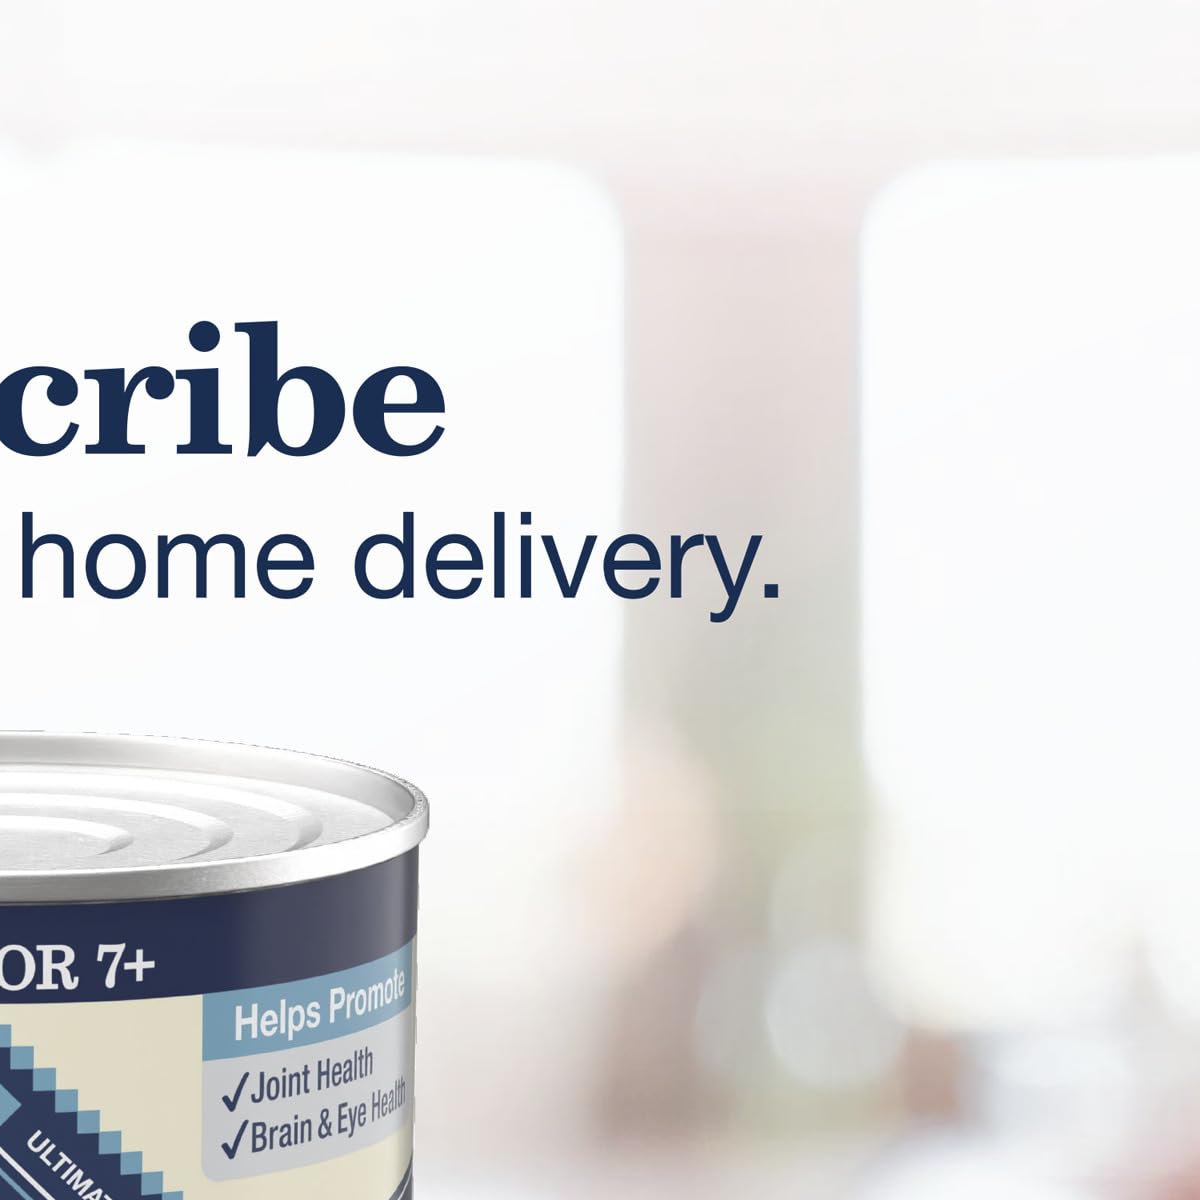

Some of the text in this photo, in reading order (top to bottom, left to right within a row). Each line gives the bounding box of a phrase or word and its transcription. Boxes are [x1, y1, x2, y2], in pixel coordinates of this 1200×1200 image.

[96, 942, 156, 989] 7+
[235, 969, 405, 1041] Helps Promote
[251, 1046, 373, 1104] Joint Health
[251, 1079, 406, 1153] Brain & Eye Health
